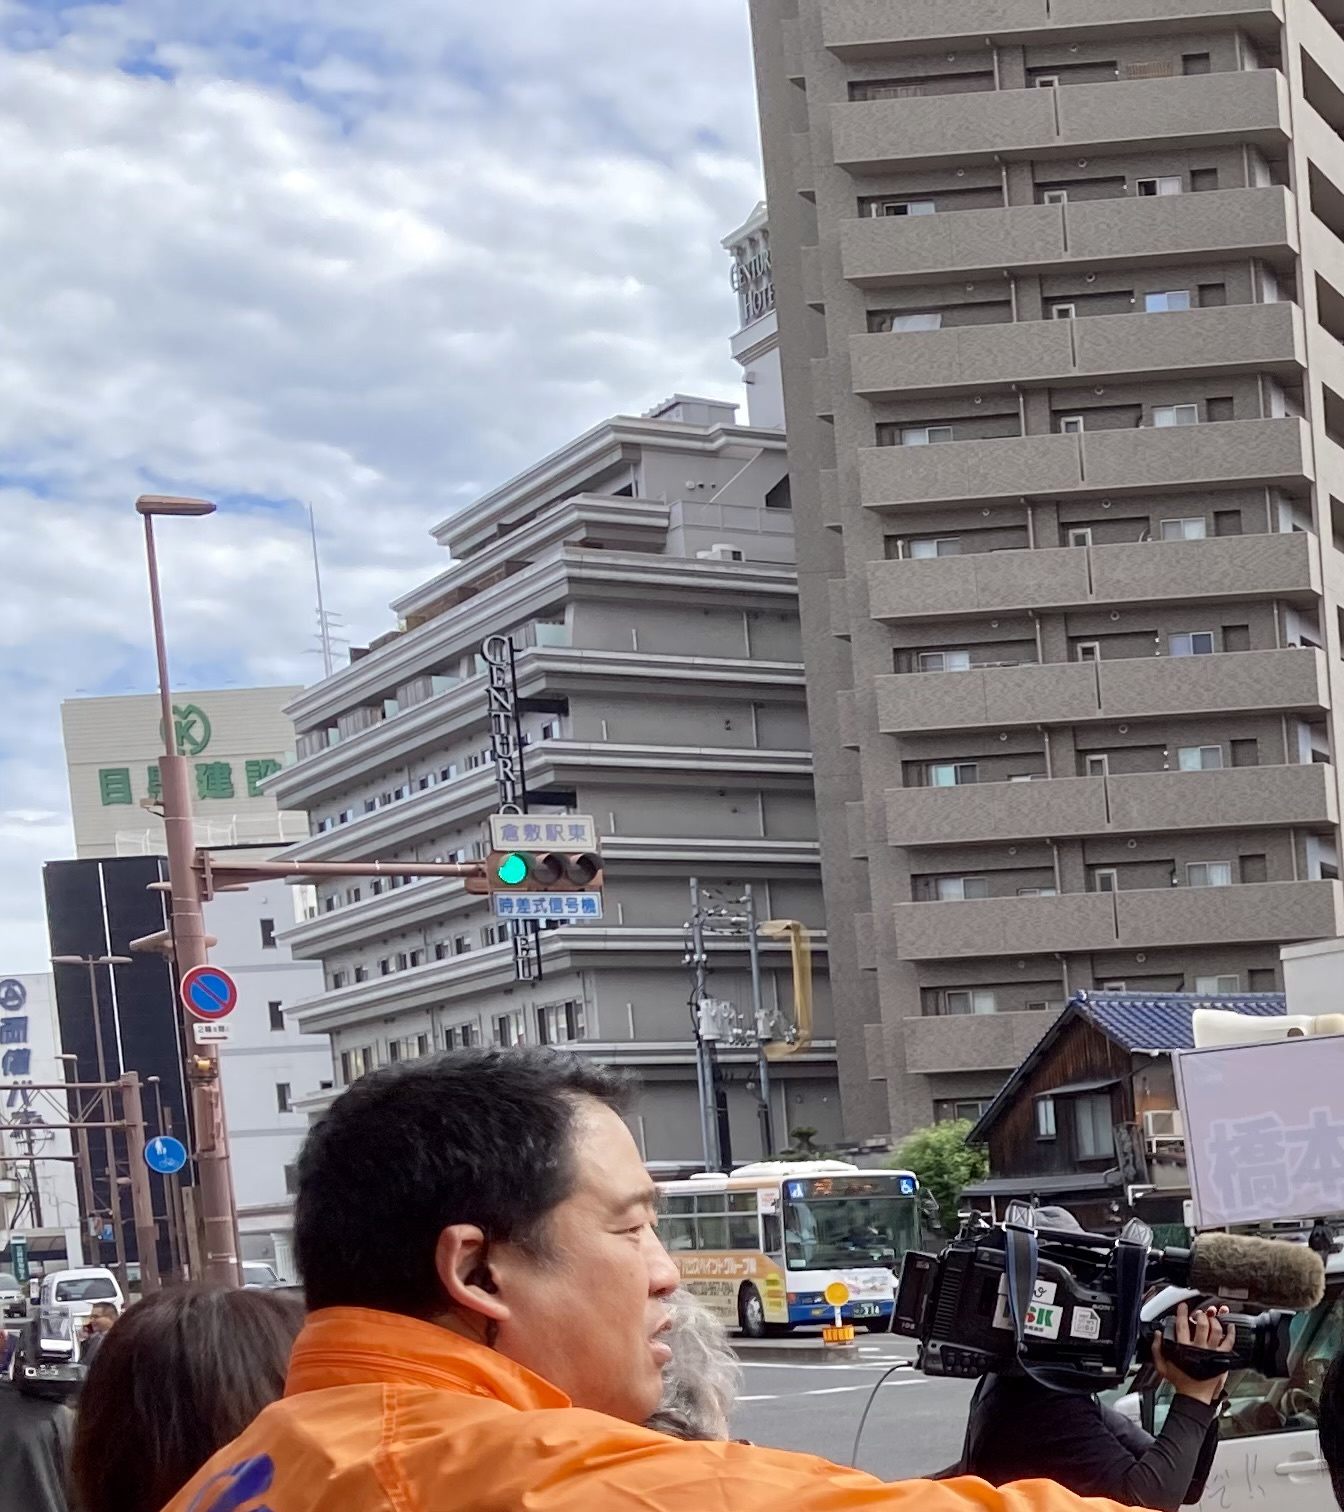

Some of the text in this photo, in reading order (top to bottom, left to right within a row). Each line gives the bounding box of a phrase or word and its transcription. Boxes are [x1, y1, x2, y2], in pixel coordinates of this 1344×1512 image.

[501, 823, 588, 843] 倉敷駅東
[499, 897, 598, 914] 時差式信号機
